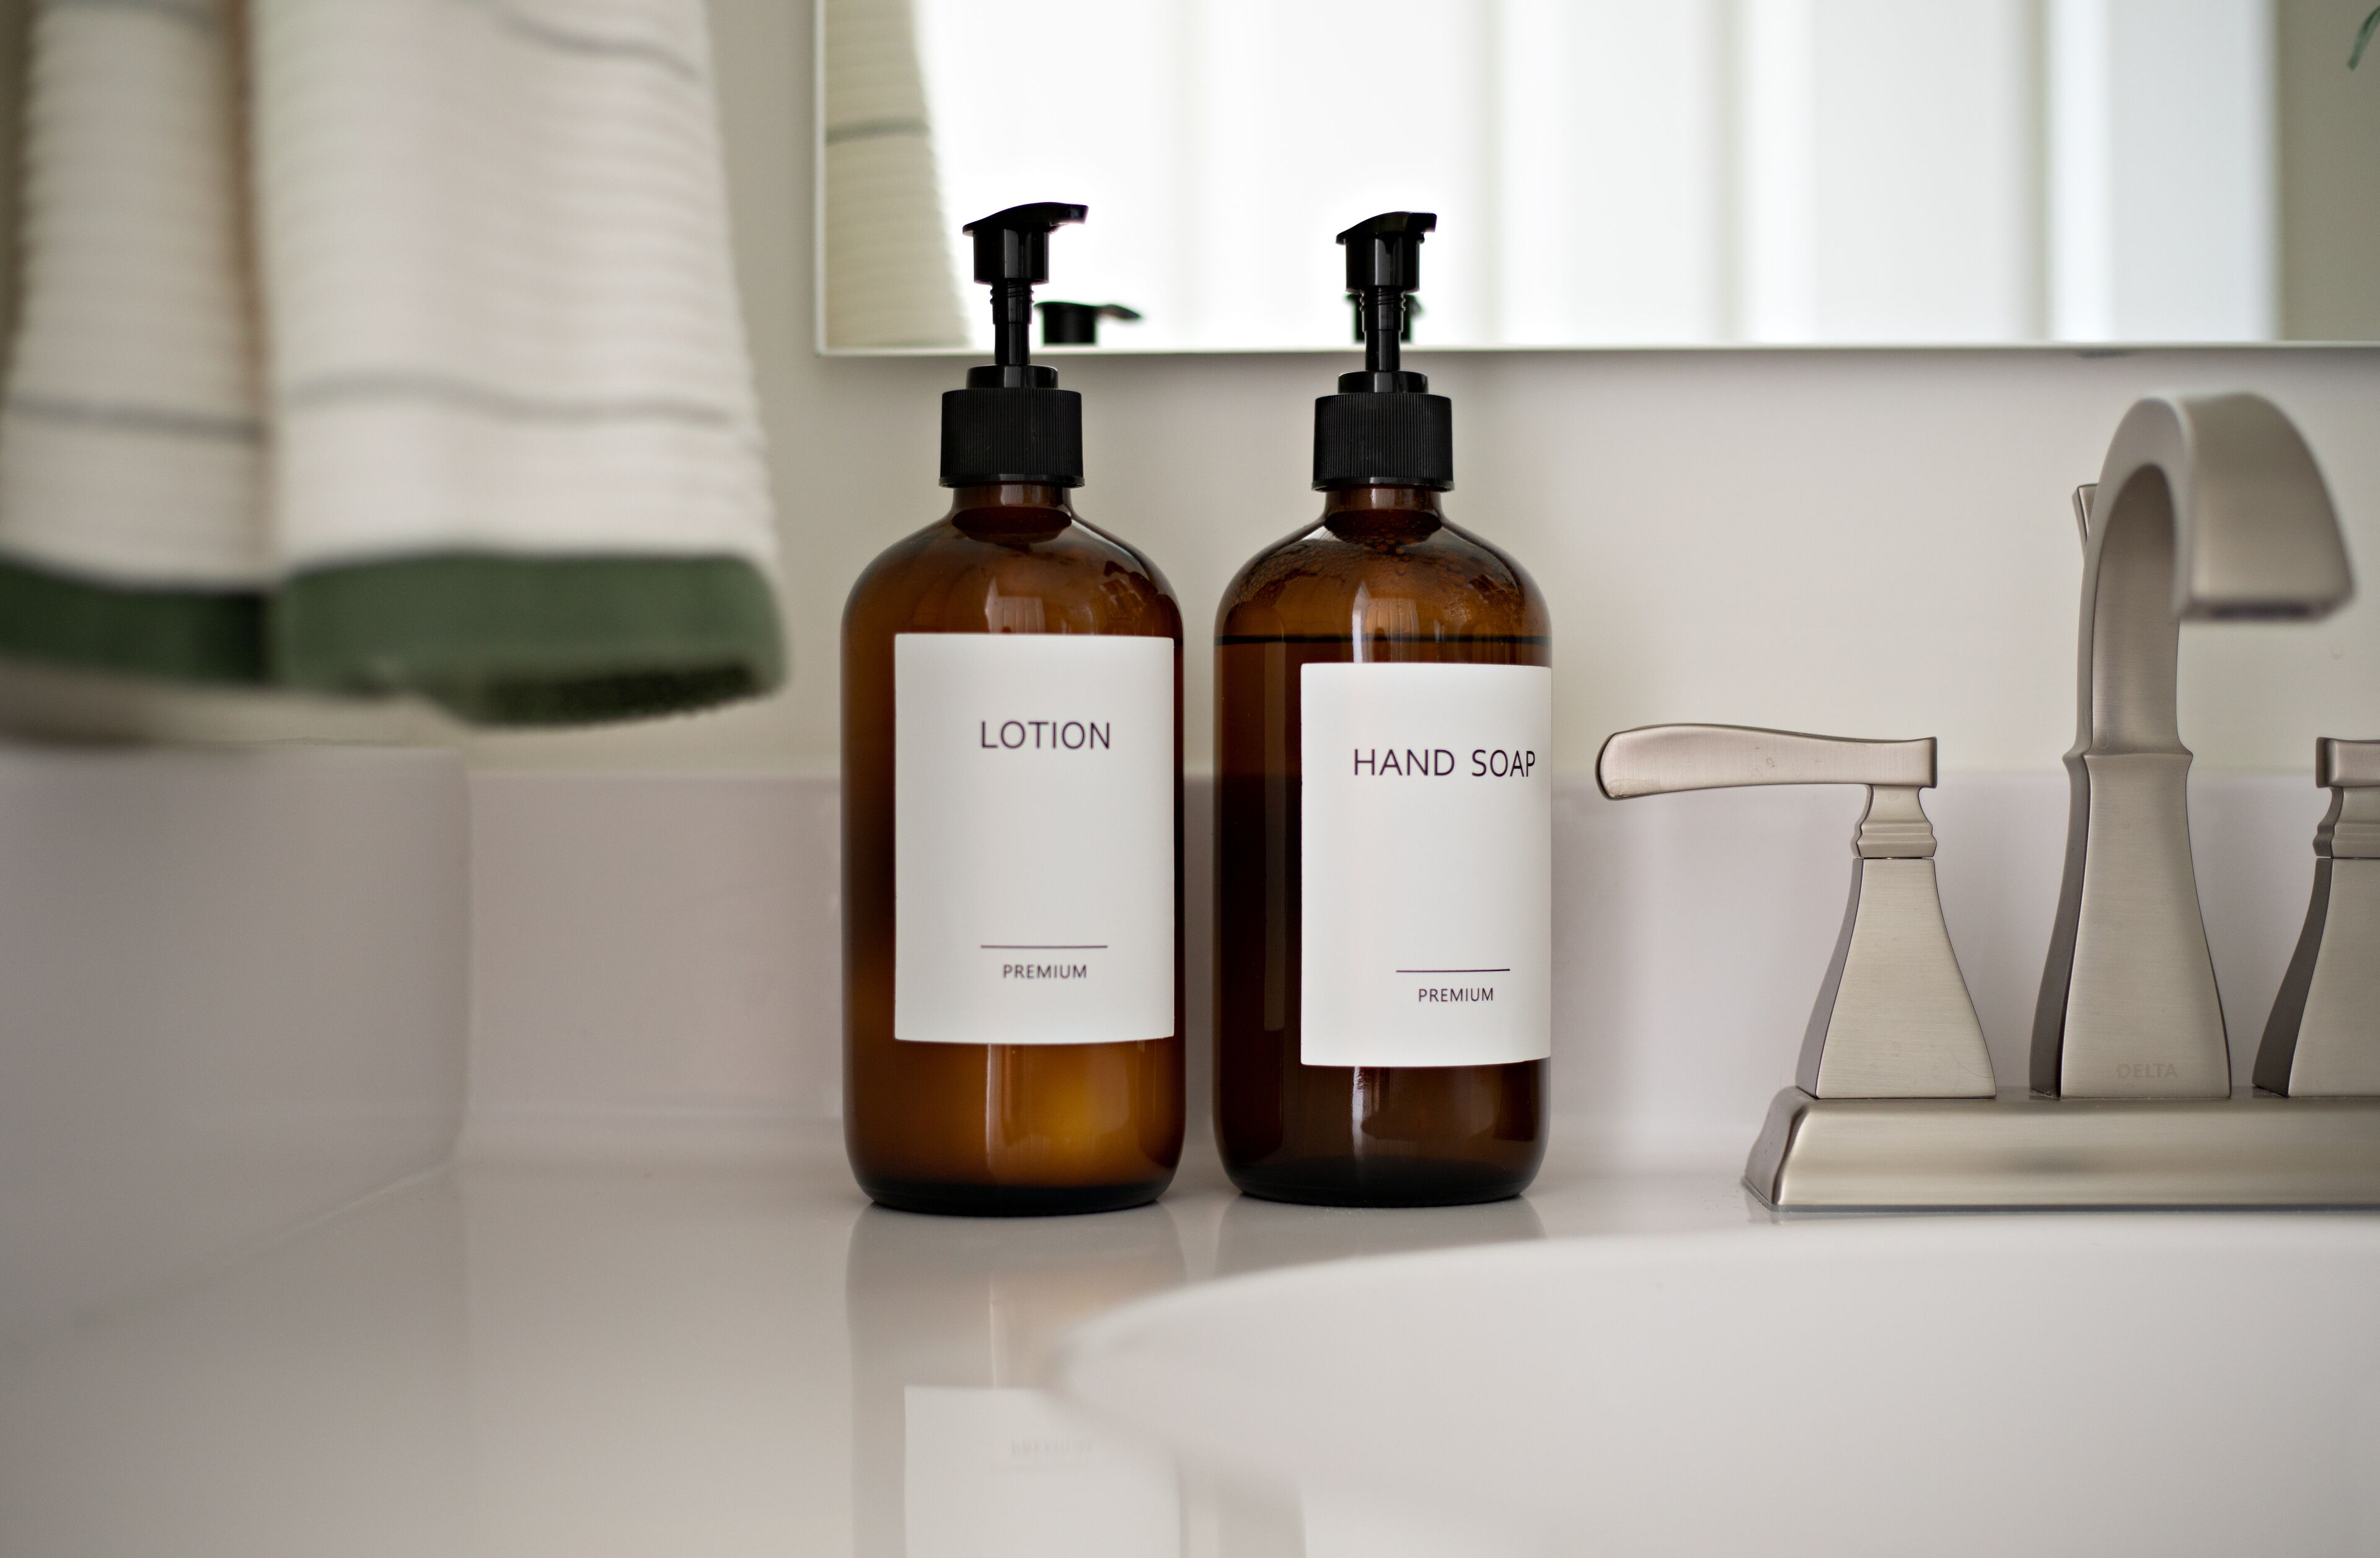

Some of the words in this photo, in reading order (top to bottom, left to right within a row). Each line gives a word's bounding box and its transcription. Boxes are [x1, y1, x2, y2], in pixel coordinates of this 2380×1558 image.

[980, 720, 1110, 750] LOTION
[1354, 748, 1455, 777] HAND
[1471, 749, 1536, 778] SOAP
[1003, 964, 1086, 979] PREMIUM
[1418, 987, 1494, 1002] PREMIUM
[2117, 1063, 2178, 1078] DELTA
